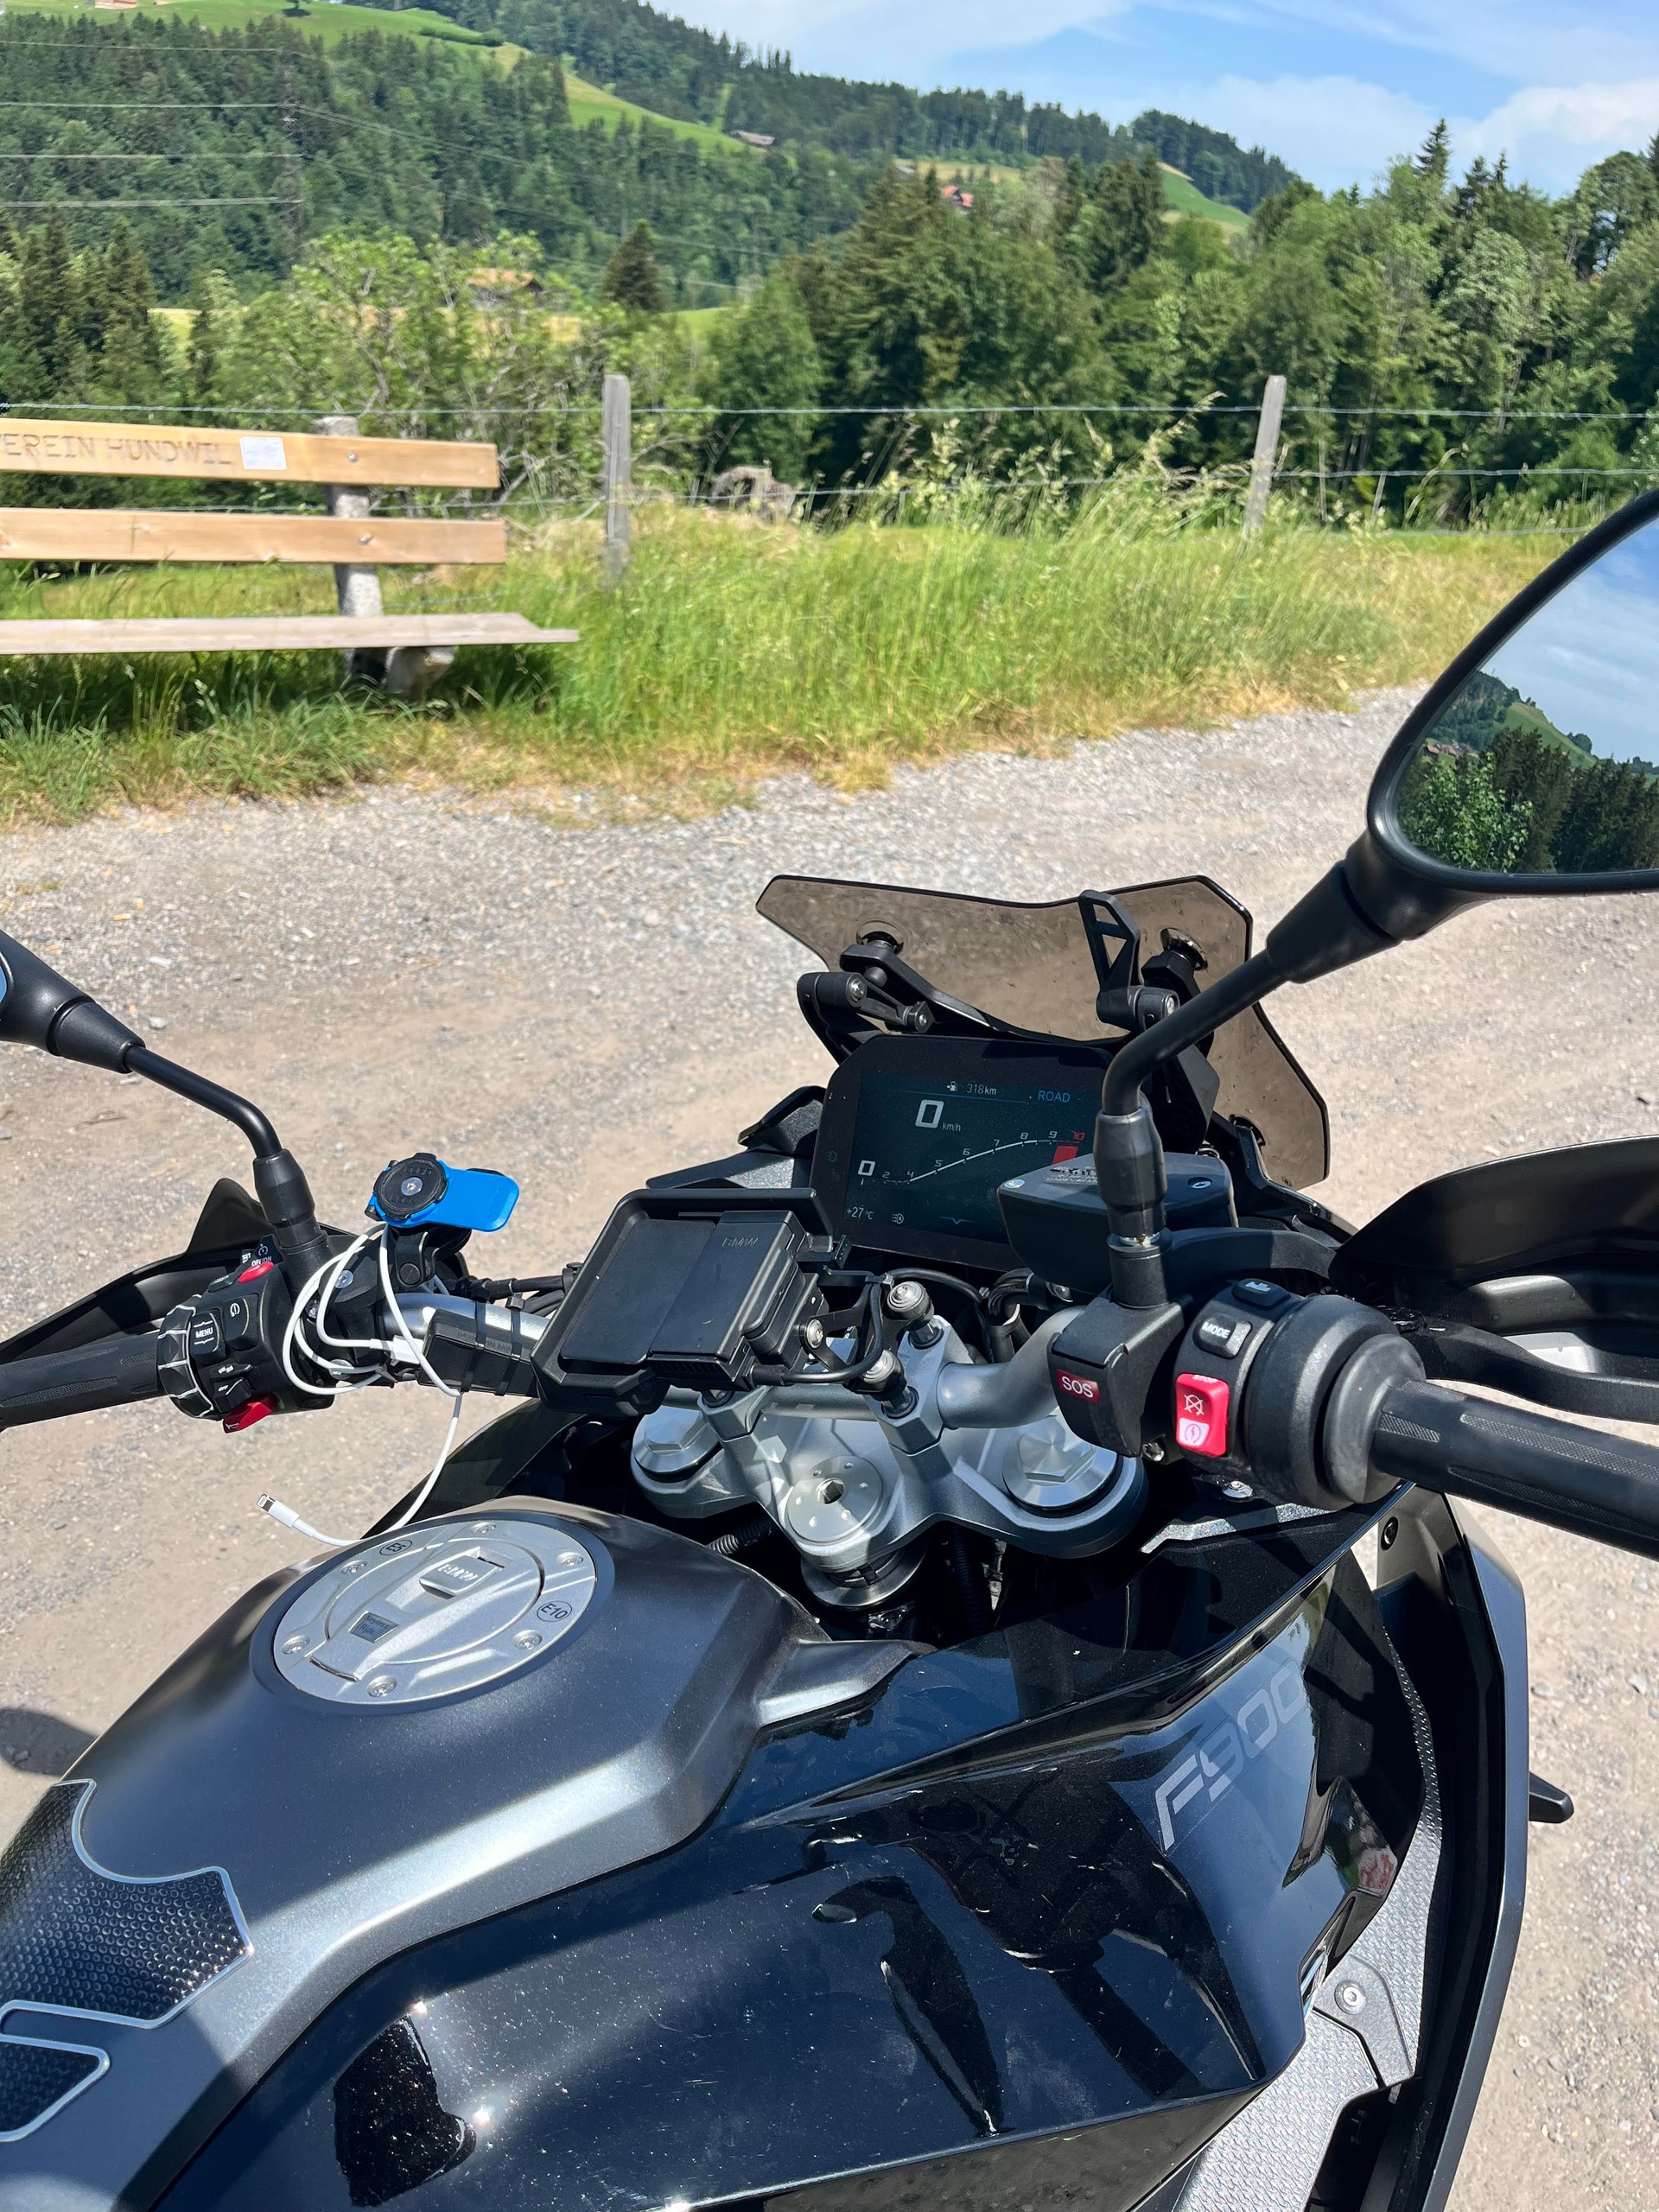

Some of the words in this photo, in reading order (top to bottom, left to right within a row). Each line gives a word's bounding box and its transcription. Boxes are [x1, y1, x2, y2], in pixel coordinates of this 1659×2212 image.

[0, 432, 97, 460] EREIN
[1038, 1090, 1071, 1103] ROAD
[914, 1099, 944, 1128] 0
[934, 1159, 944, 1167] 5
[963, 1147, 971, 1156] 6
[1048, 1130, 1058, 1139] 9
[195, 1327, 213, 1338] MENU
[1202, 1321, 1230, 1339] MODE
[1062, 1376, 1094, 1398] SOS
[540, 1602, 569, 1619] E10
[359, 1623, 376, 1635] Ride
[1155, 1659, 1307, 1851] F900
